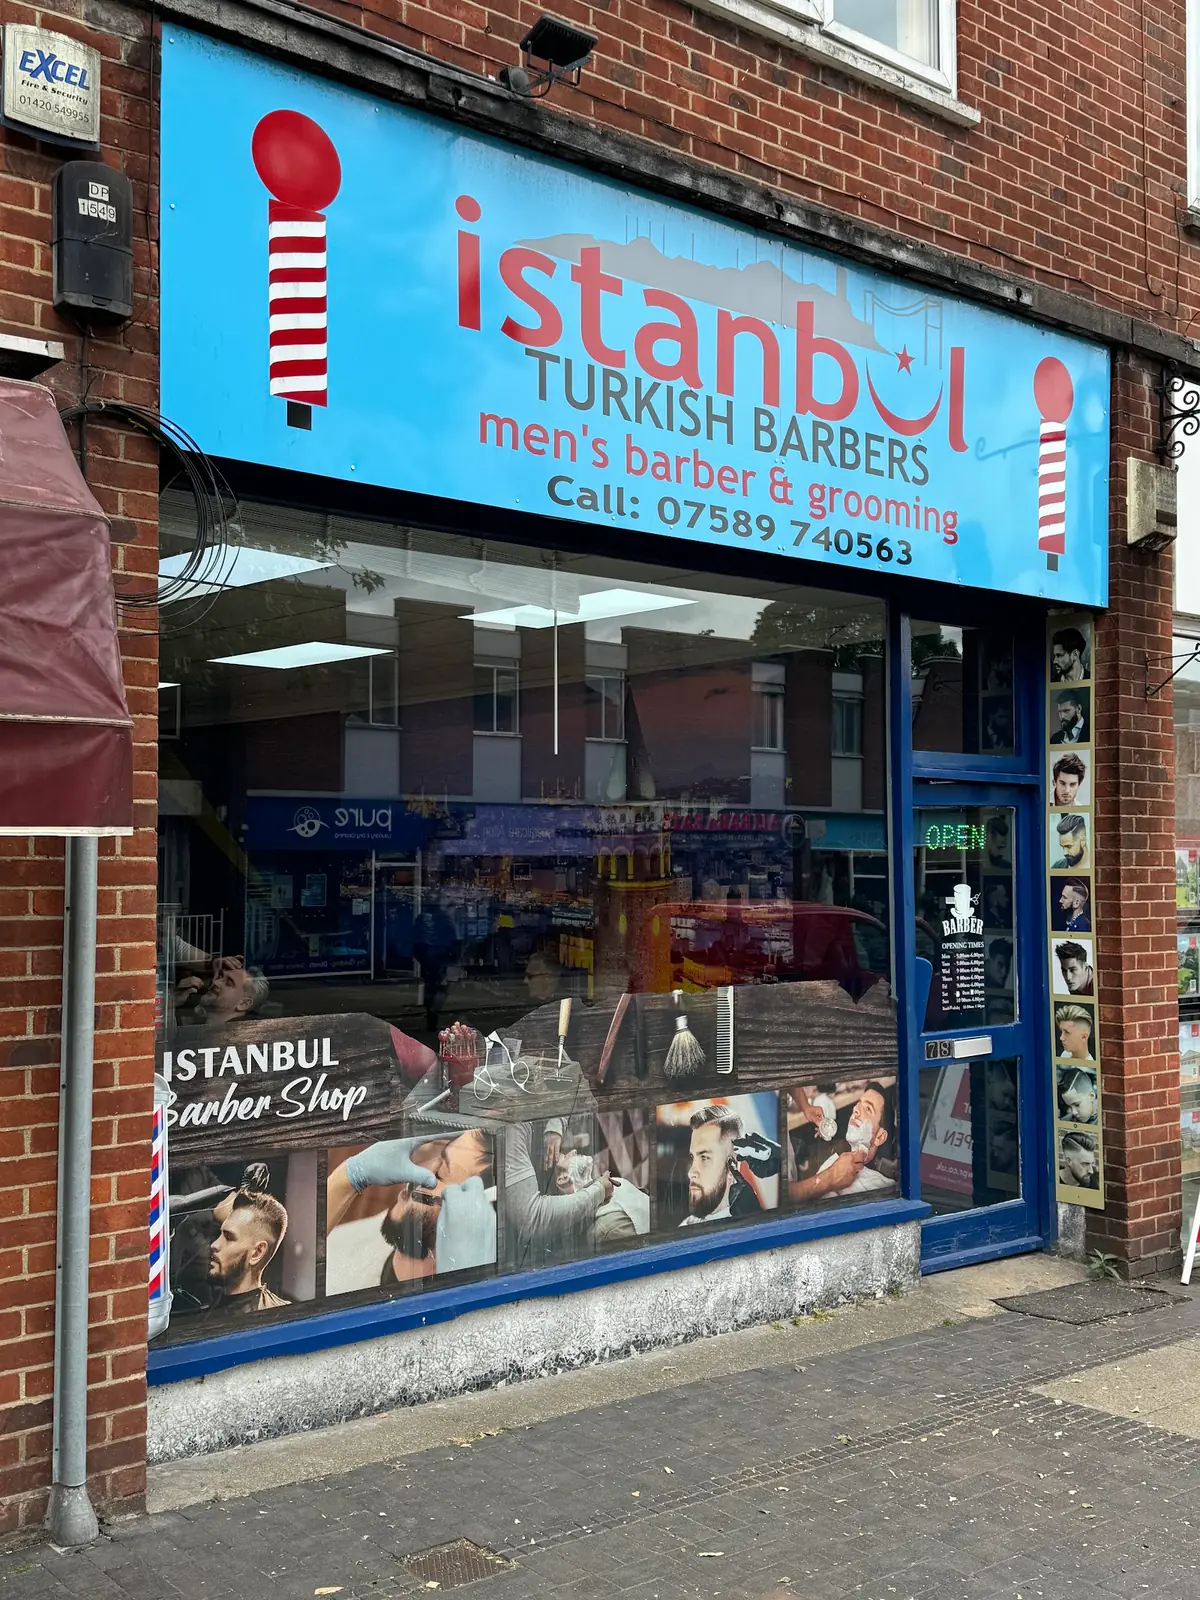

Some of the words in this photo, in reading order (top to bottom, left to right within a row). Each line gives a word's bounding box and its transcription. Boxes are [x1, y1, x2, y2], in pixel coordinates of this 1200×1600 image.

[19, 49, 90, 91] EXCEL
[21, 79, 40, 90] Fire
[51, 87, 88, 105] Security
[19, 95, 52, 111] 01420
[54, 104, 89, 123] 549955
[91, 184, 109, 197] DP
[82, 203, 115, 219] 1549
[455, 195, 969, 452] istanbul
[525, 347, 733, 446] TURKISH
[754, 406, 929, 486] BARBERS
[480, 411, 609, 469] men's
[626, 433, 756, 497] barber
[769, 466, 794, 506] &
[808, 482, 959, 545] grooming
[547, 475, 640, 519] Call:
[657, 496, 776, 541] 07589
[790, 519, 912, 566] 740563
[926, 824, 985, 850] OPEN
[942, 916, 984, 937] BARBER
[941, 942, 967, 950] OPENING
[967, 941, 984, 949] TIMES
[163, 1037, 339, 1082] ISTANBUL
[927, 1041, 951, 1058] 78
[276, 1073, 368, 1121] Shop
